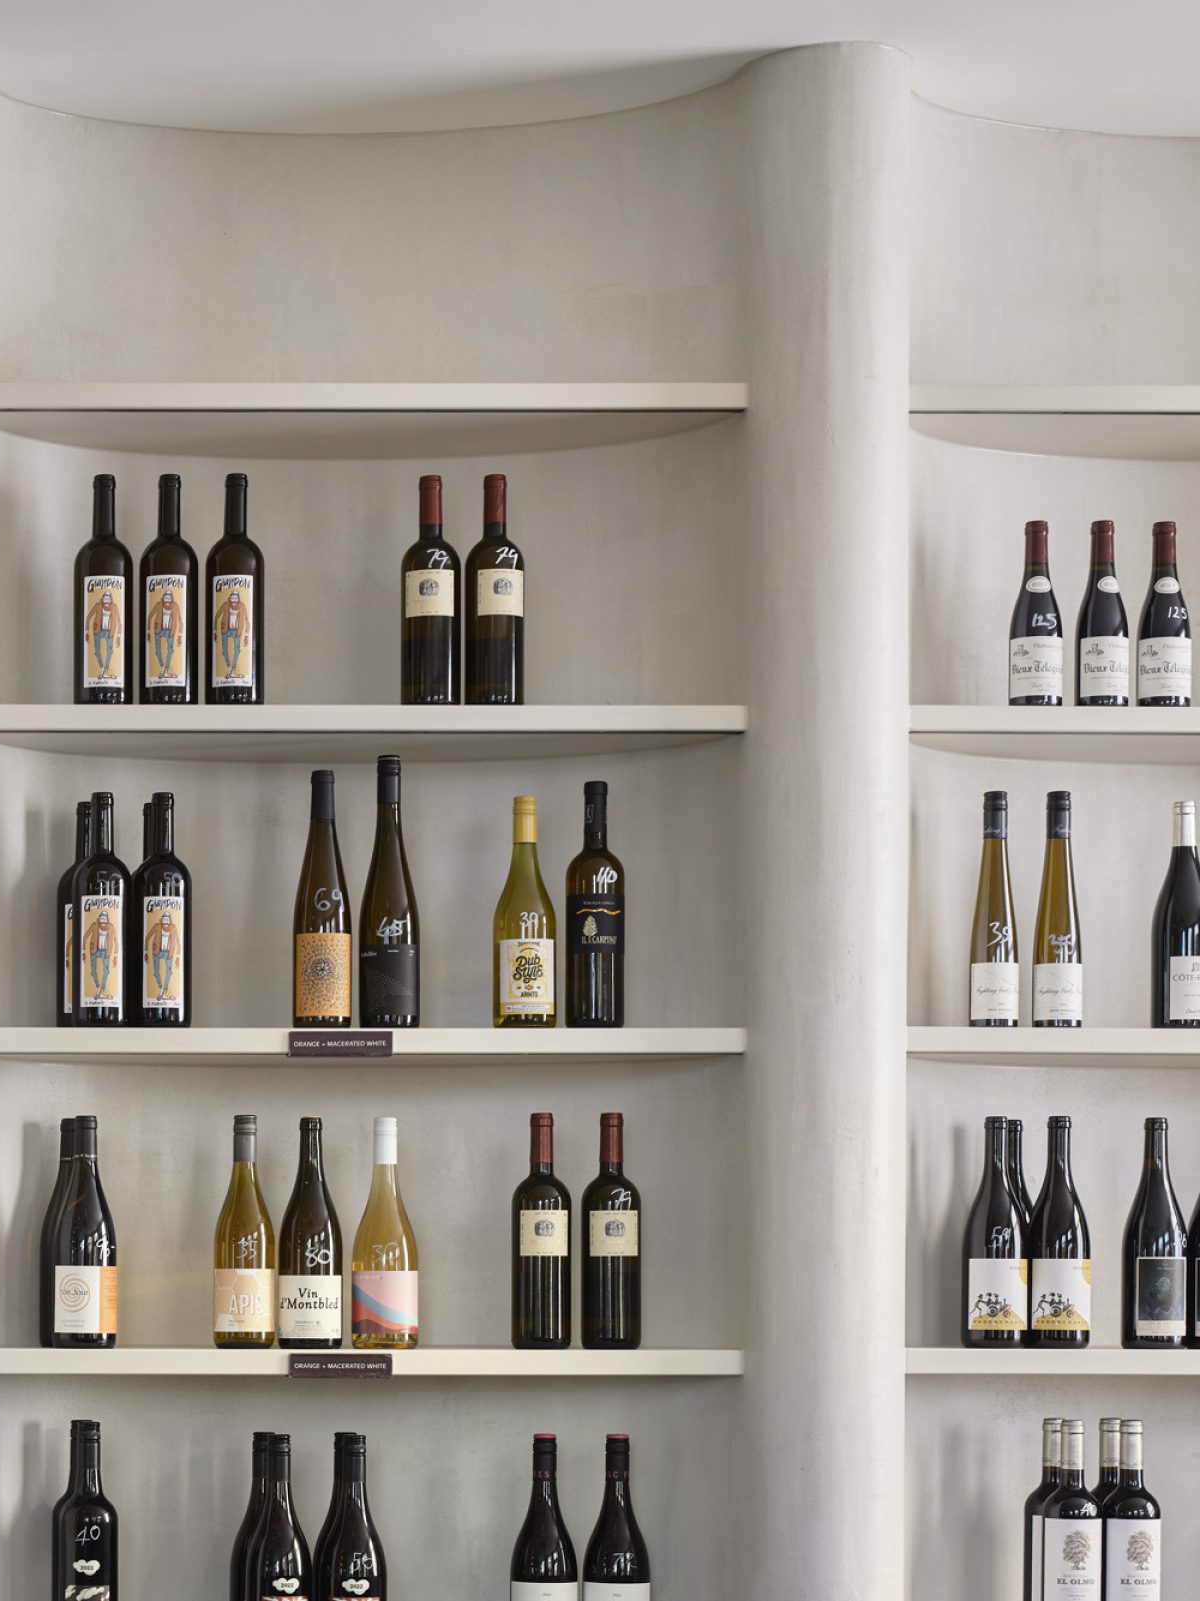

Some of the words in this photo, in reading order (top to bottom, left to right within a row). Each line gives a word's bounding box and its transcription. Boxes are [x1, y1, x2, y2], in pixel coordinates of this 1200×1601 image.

[1167, 606, 1188, 619] 125
[1031, 612, 1058, 630] 125
[515, 953, 541, 967] Dub
[305, 1246, 331, 1268] 80
[298, 1287, 319, 1298] Vin
[228, 1294, 265, 1314] APIS
[75, 1524, 101, 1546] 40
[1056, 1577, 1069, 1585] EL
[1069, 1577, 1095, 1585] OLMO
[1120, 1577, 1133, 1585] EL
[1133, 1577, 1158, 1585] OLMO
